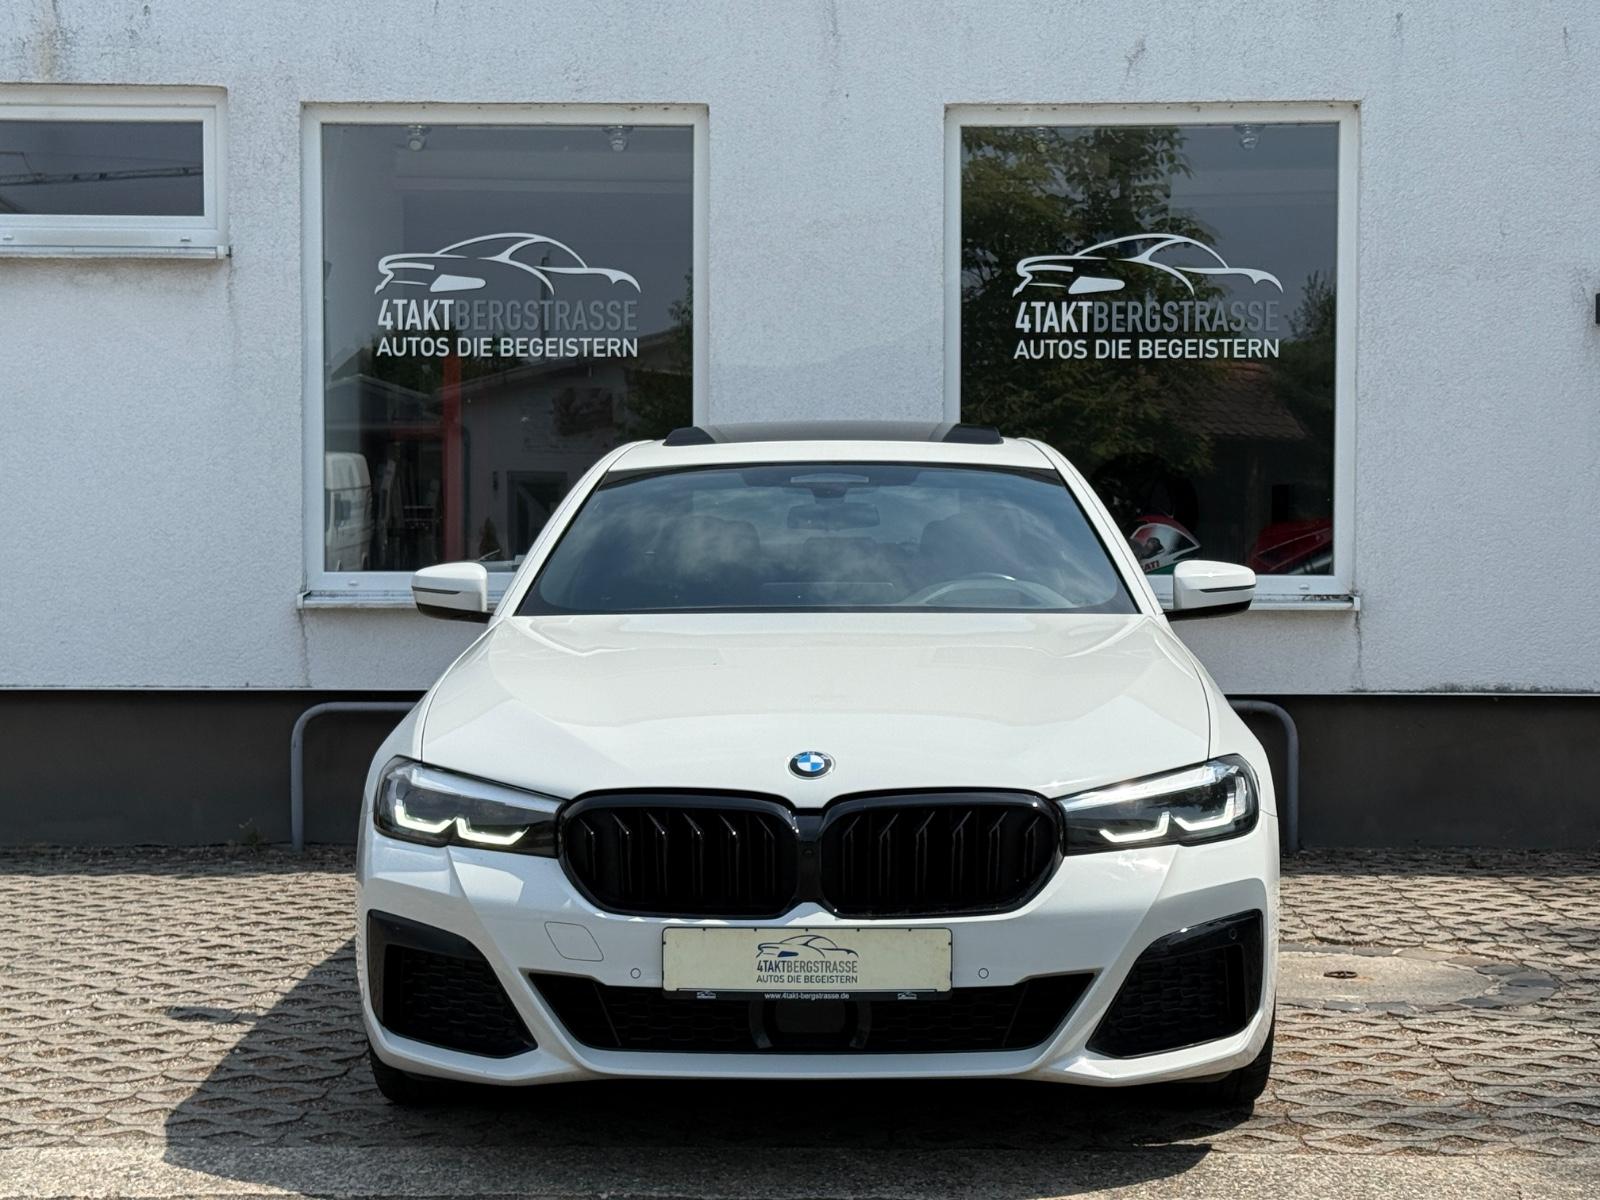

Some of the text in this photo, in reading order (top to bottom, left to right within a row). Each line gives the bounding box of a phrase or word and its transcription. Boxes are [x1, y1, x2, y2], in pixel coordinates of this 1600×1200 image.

[377, 299, 638, 331] 4TAKTBERGSTRASSE
[1015, 301, 1280, 333] 4TAKTBERGSTRASSE
[376, 337, 638, 358] AUTOS DIE BEGEISTERN
[1013, 338, 1280, 360] AUTOS DIE BEGEISTERN
[756, 960, 858, 973] 4TAKTBERGSTRASSE
[756, 975, 858, 984] AUTOS DIE BEGEISTERN
[764, 992, 850, 1000] www.4takt-bergstrasse.de
